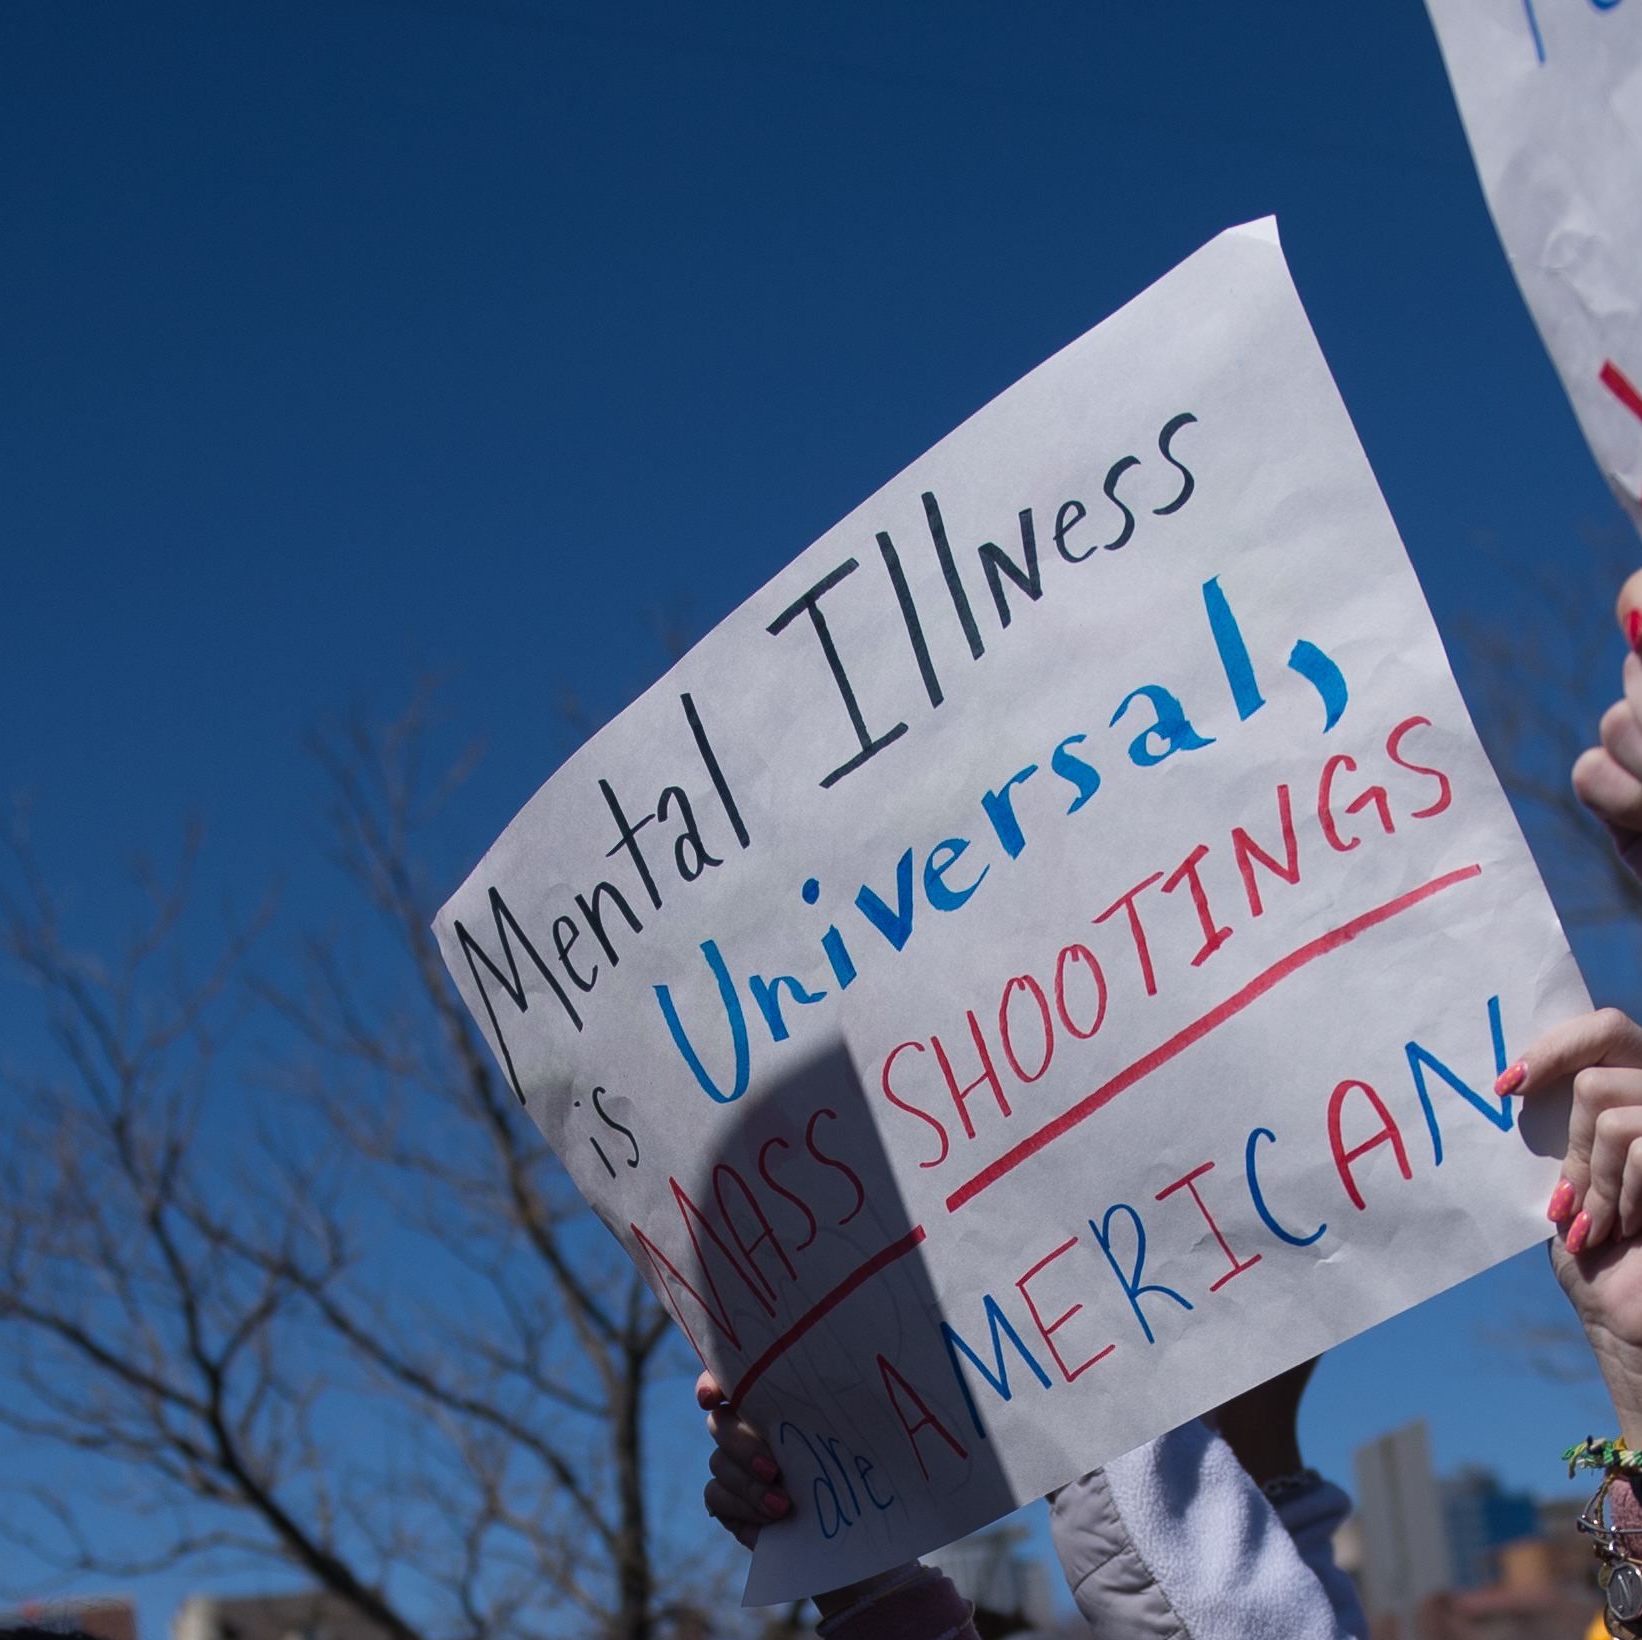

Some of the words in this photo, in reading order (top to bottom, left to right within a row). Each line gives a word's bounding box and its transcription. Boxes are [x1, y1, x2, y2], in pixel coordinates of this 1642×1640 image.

[453, 690, 751, 1106] Mental
[573, 1085, 641, 1179] is
[651, 573, 1349, 1105] Universal,
[629, 1107, 865, 1372] MASS
[882, 714, 1455, 1171] SHOOTINGS
[780, 1420, 896, 1540] are
[875, 994, 1516, 1463] AMERICAN
